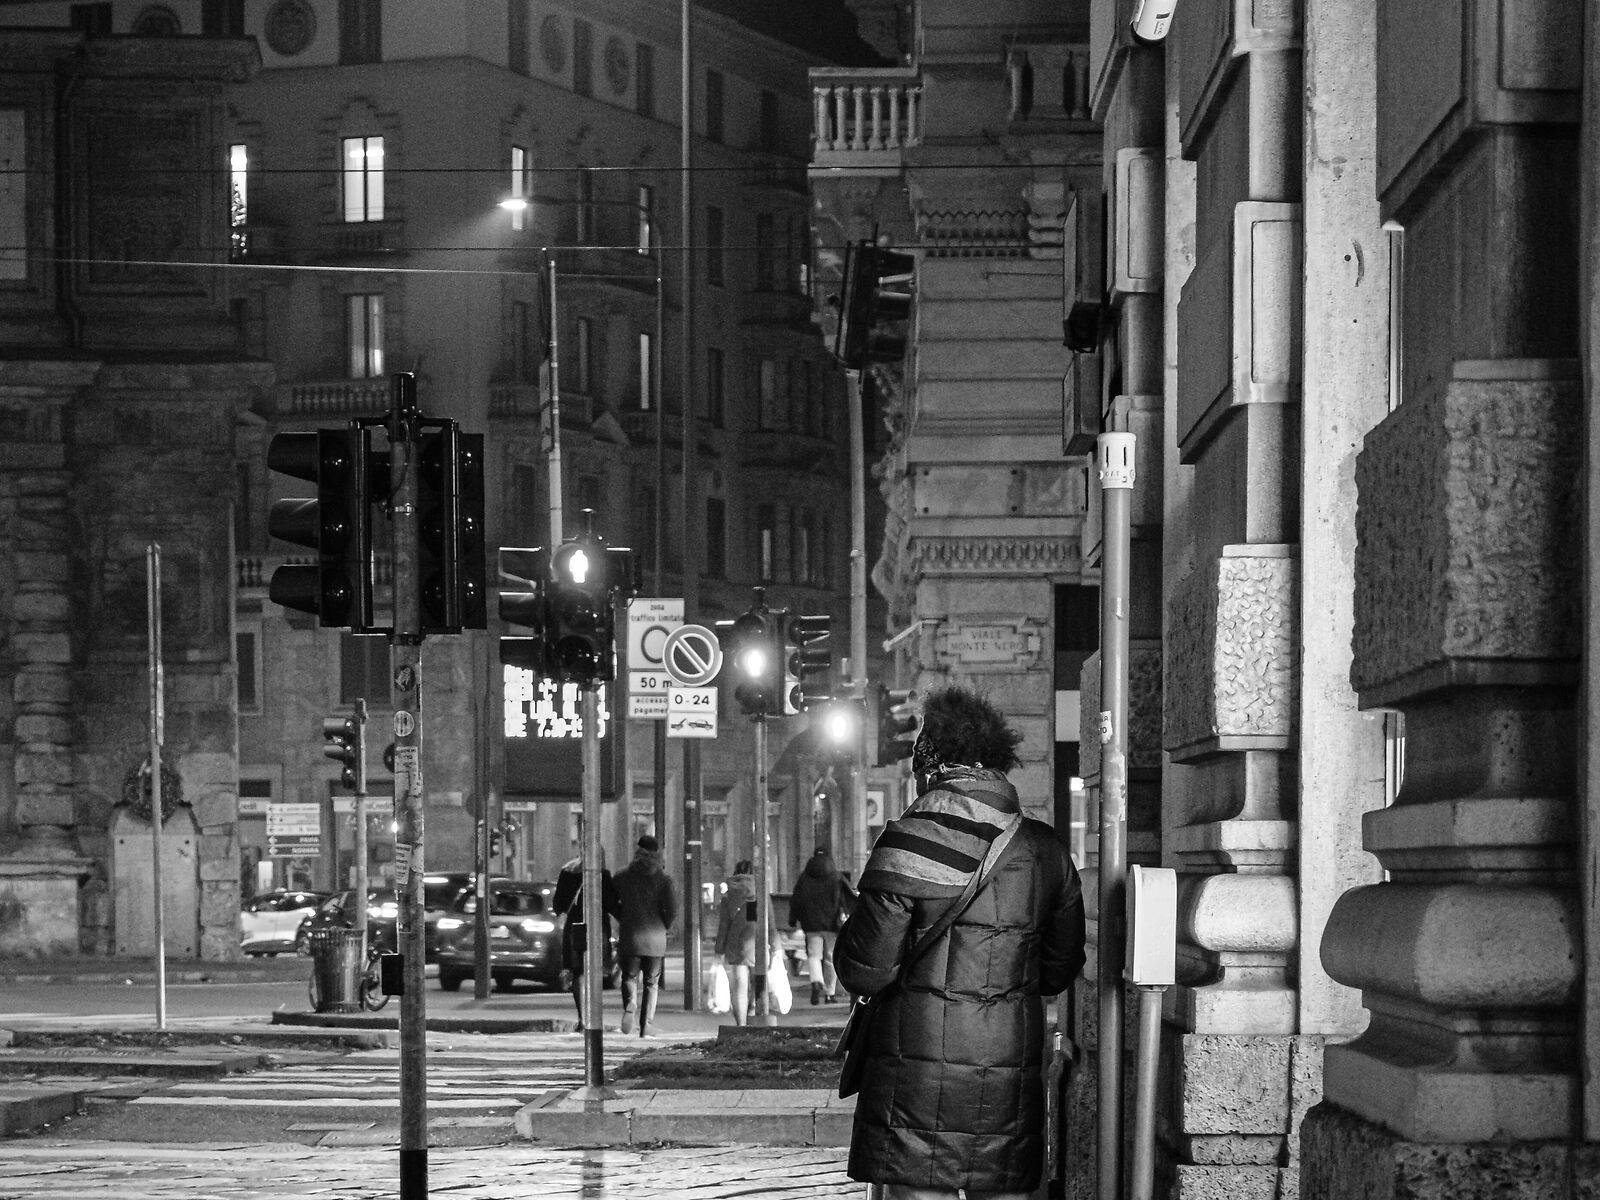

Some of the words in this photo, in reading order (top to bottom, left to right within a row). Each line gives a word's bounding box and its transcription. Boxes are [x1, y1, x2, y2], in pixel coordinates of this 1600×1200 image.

[970, 630, 1002, 640] VIALE
[951, 641, 987, 651] MONTE
[640, 677, 657, 688] 50
[692, 694, 710, 705] 24
